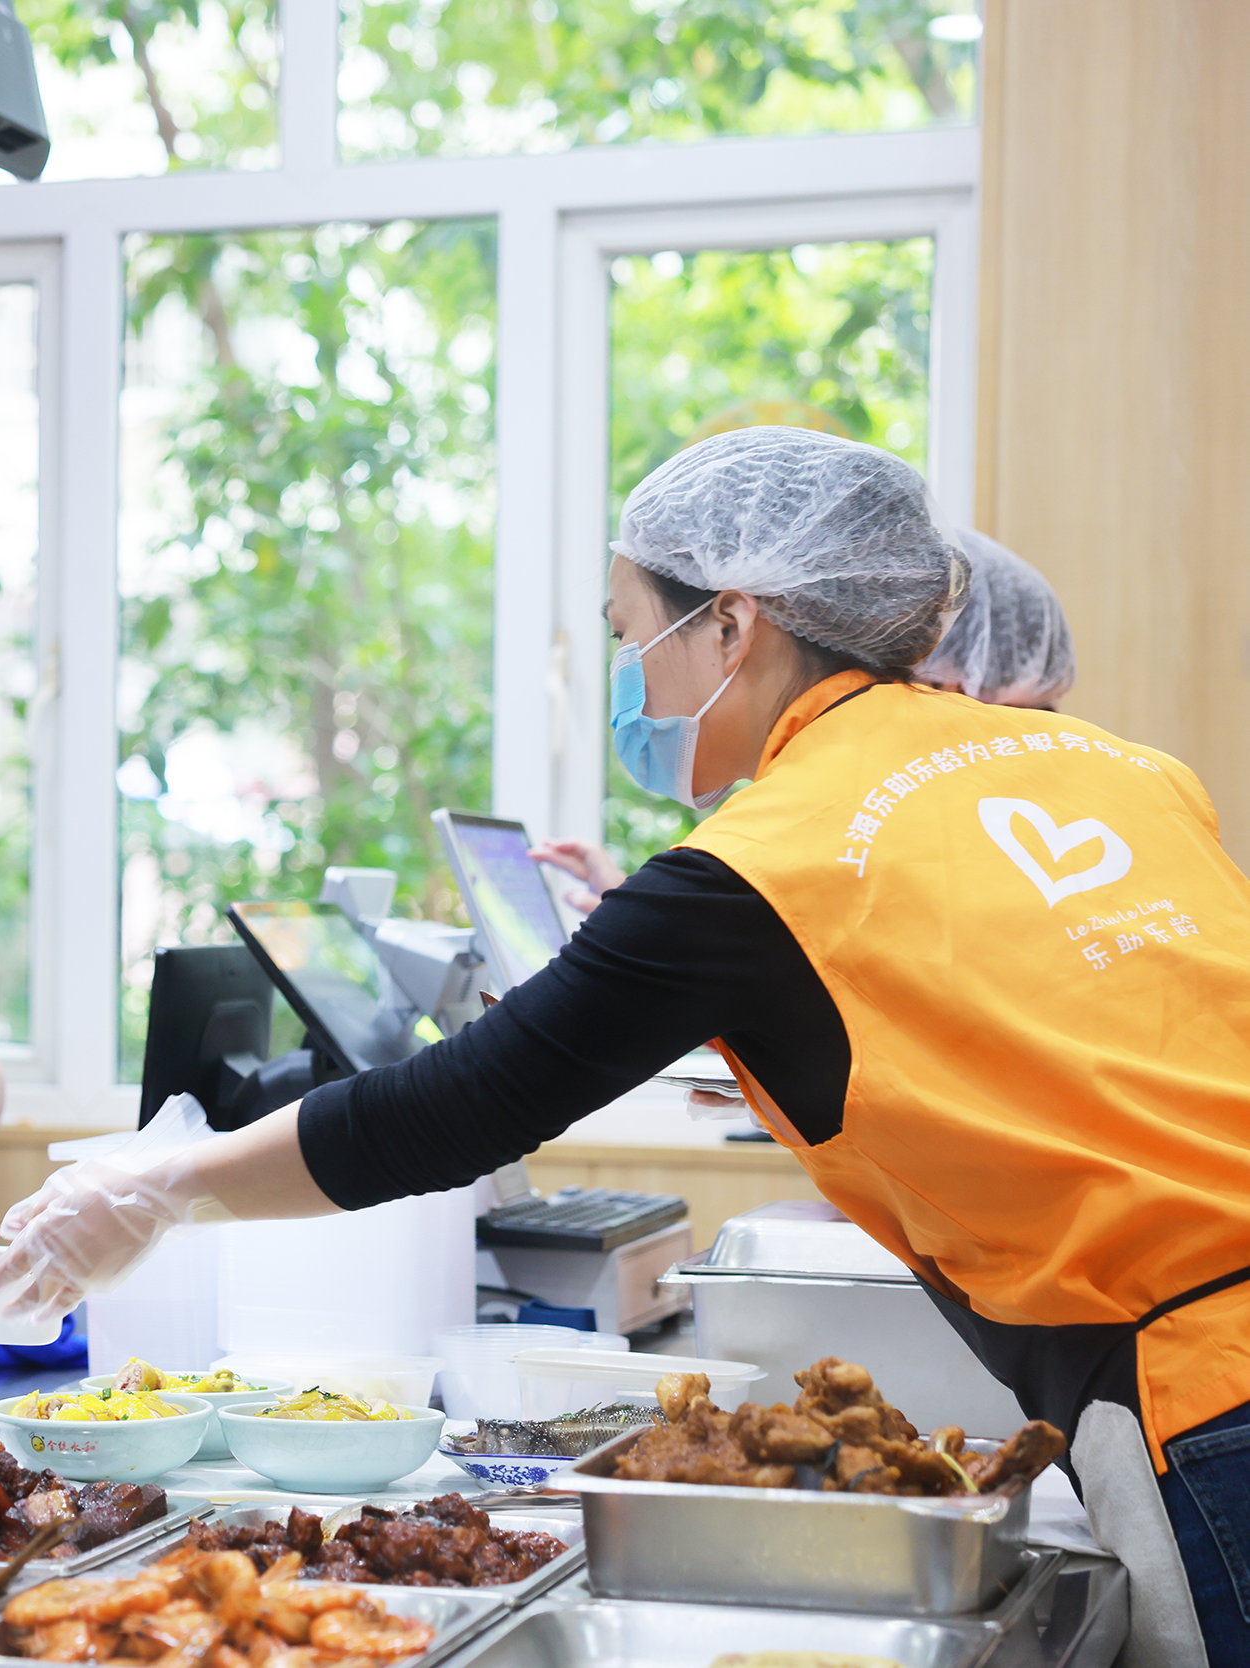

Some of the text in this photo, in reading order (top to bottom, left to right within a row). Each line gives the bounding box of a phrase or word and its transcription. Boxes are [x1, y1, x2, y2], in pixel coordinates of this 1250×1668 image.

[837, 730, 1162, 878] 上海乐助乐龄为老服务中心
[1081, 914, 1201, 970] 乐助乐龄
